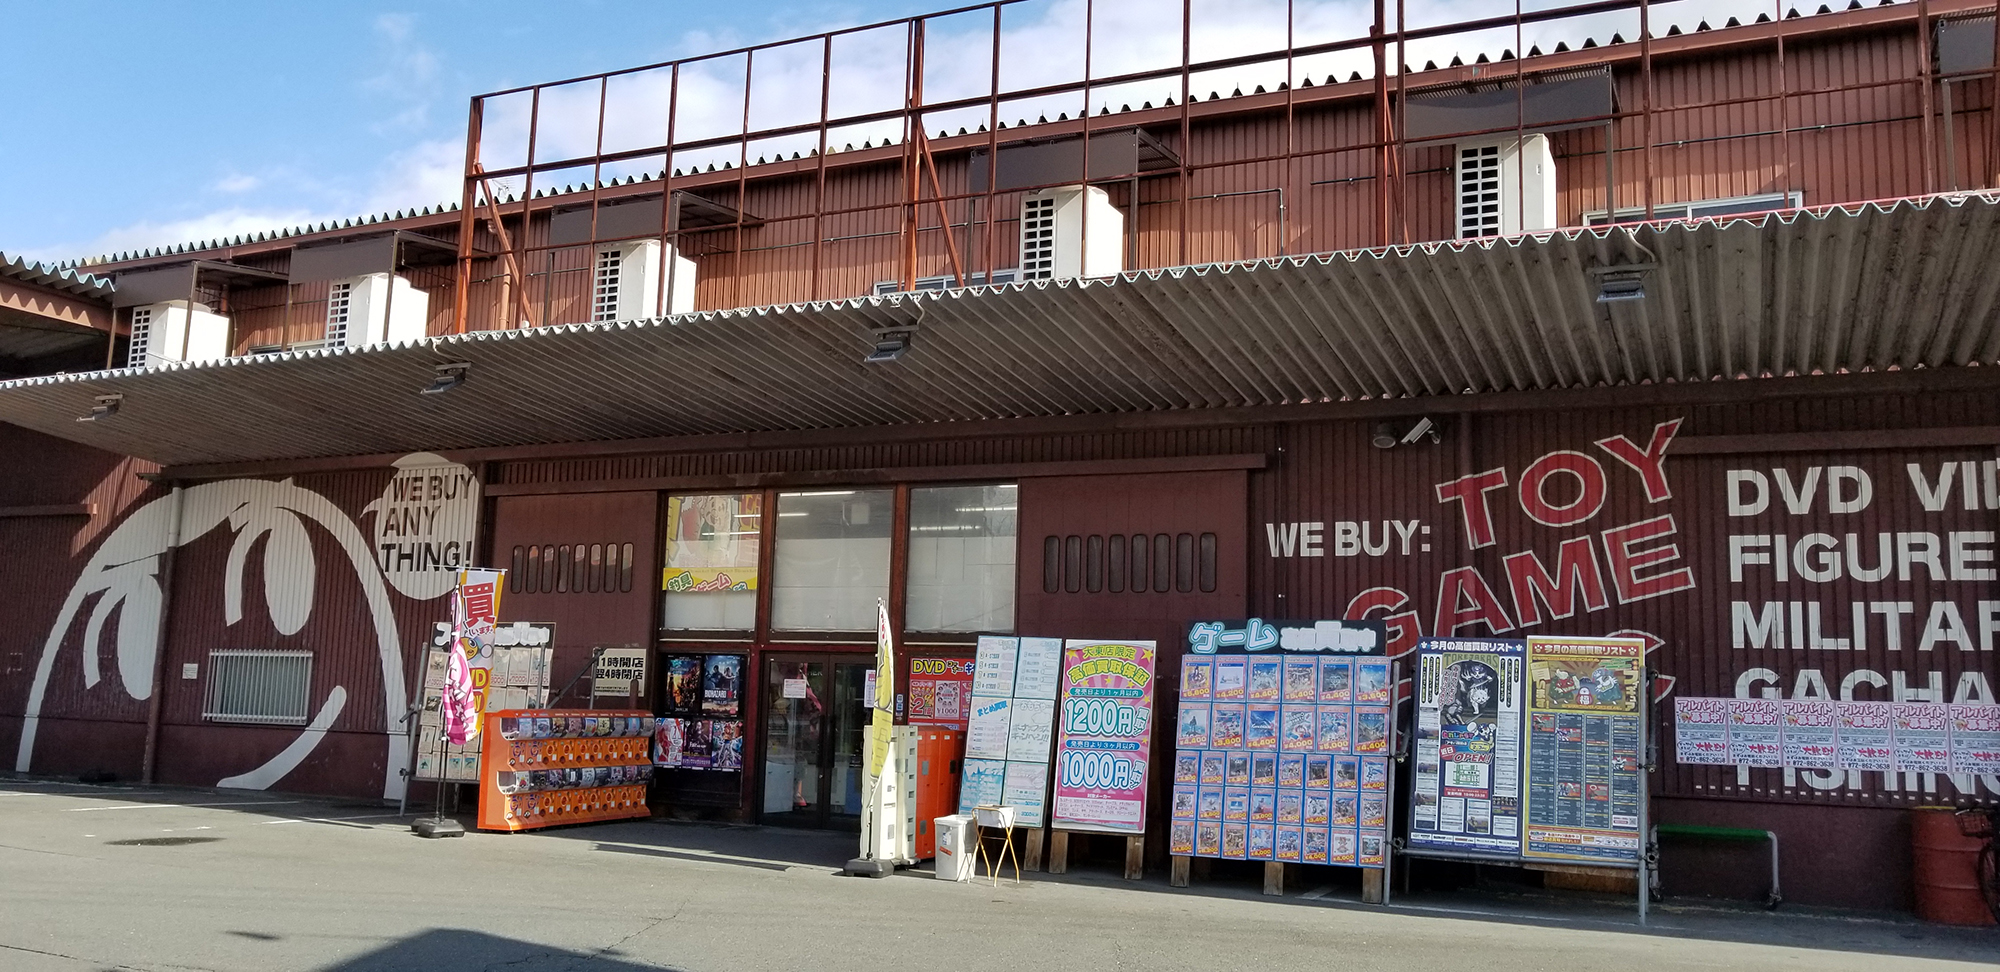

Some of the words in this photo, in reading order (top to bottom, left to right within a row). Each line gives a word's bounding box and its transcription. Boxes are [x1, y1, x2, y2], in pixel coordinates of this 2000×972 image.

[393, 476, 423, 503] WE
[427, 474, 474, 501] BUY
[1435, 417, 1684, 549] TOY
[1726, 465, 1873, 516] DVD
[383, 505, 441, 537] ANY
[1266, 522, 1324, 557] WE
[1334, 520, 1431, 556] BUY:
[381, 541, 472, 573] THING!
[1729, 531, 1997, 582] FIGURE
[1343, 513, 1696, 659] GAME
[462, 582, 496, 628] 買
[1190, 619, 1278, 653] ゲーム
[1430, 641, 1513, 652] 今月の高価買取リスト
[1544, 644, 1626, 655] 今月の高価買取リスト
[1083, 646, 1136, 659] 大東店限定
[1067, 659, 1150, 687] 高価買取保証
[1734, 668, 1997, 704] GACHA
[1065, 699, 1135, 735] 1200円
[1677, 699, 1724, 713] アルバイト
[1729, 700, 1777, 713] アルバイト
[1783, 702, 1832, 715] アルバイト
[1837, 703, 1888, 717] アルバイト
[1893, 705, 1945, 718] アルバイト
[1061, 751, 1131, 789] 1000円
[1454, 753, 1494, 765] OPEN!
